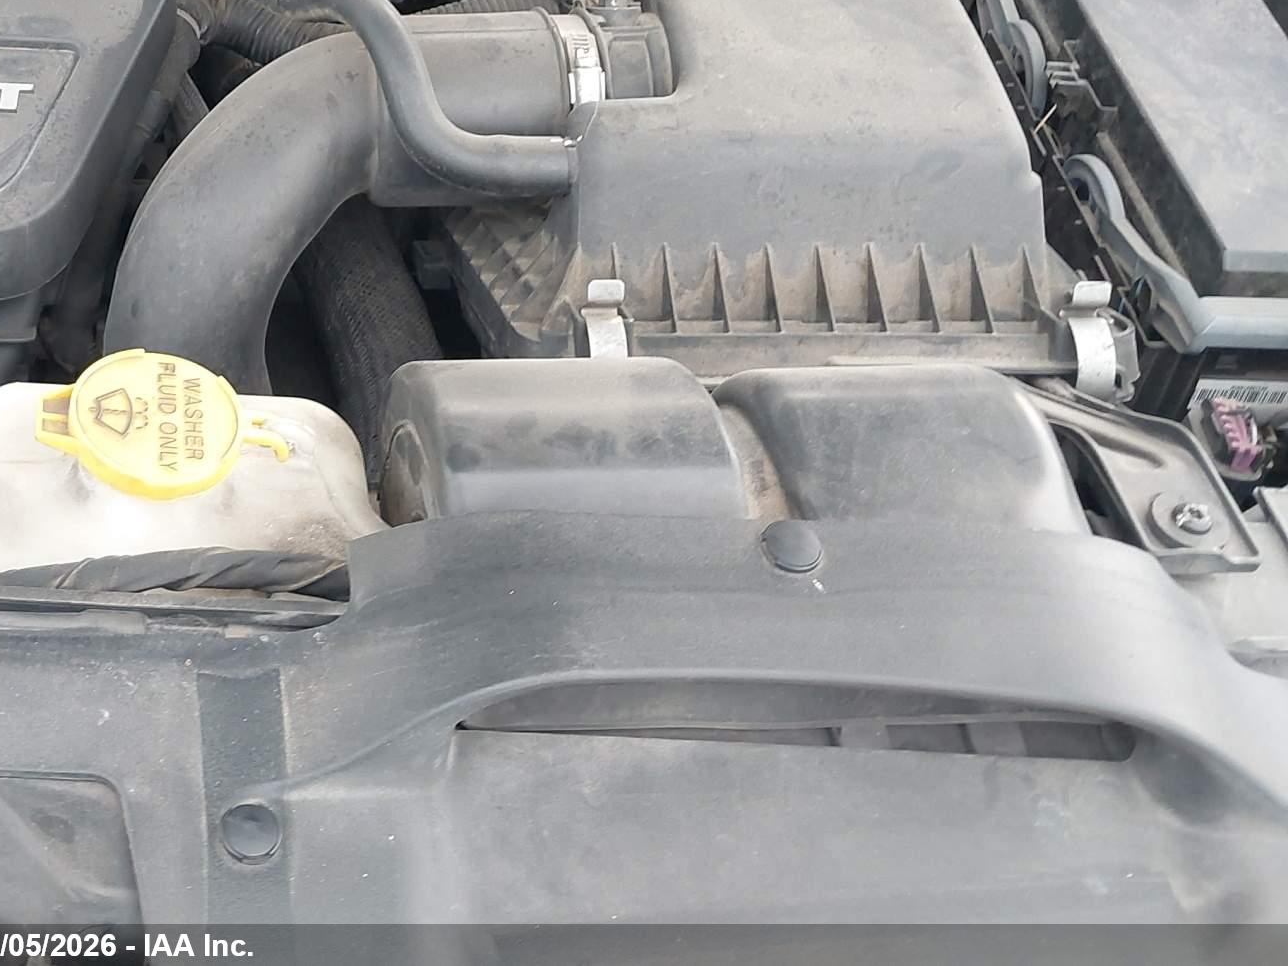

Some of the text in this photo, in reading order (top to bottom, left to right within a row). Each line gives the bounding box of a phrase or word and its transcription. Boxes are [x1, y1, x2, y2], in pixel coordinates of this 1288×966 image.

[156, 361, 179, 472] FLUID ONLY
[183, 377, 205, 461] WASHER
